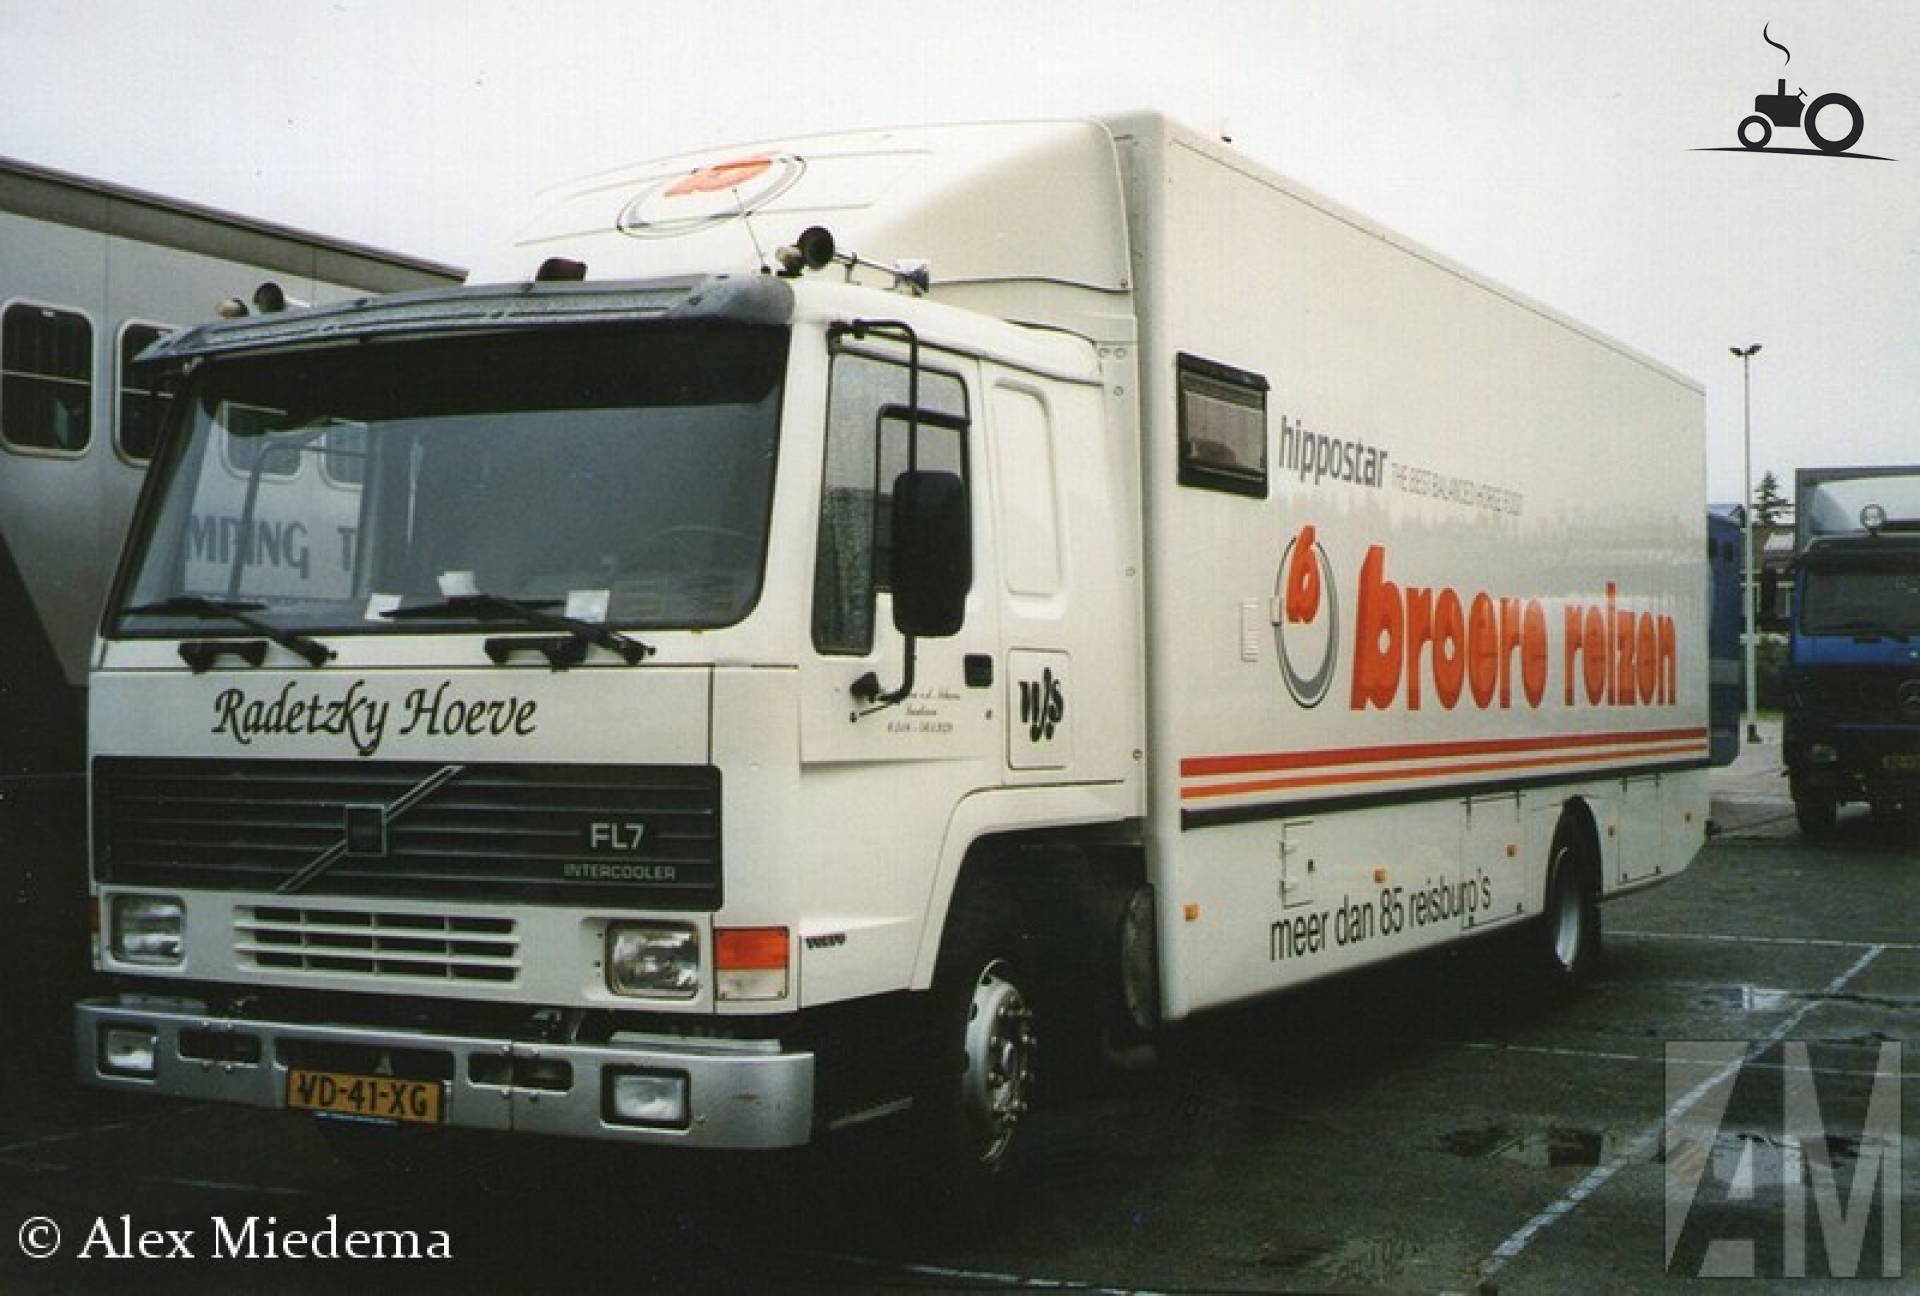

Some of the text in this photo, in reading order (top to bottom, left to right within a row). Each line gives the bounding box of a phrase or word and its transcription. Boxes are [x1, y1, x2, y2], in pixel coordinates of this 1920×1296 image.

[1279, 415, 1388, 488] hippostar
[1350, 545, 1676, 711] broere reizen
[211, 680, 537, 756] Radetzky Hoeve
[563, 863, 676, 881] INTERCOOLER
[591, 822, 644, 850] FL7
[1270, 911, 1329, 962] meer
[1336, 894, 1374, 946] dan
[1380, 887, 1404, 936] 85
[299, 1073, 427, 1117] VD-41-XG
